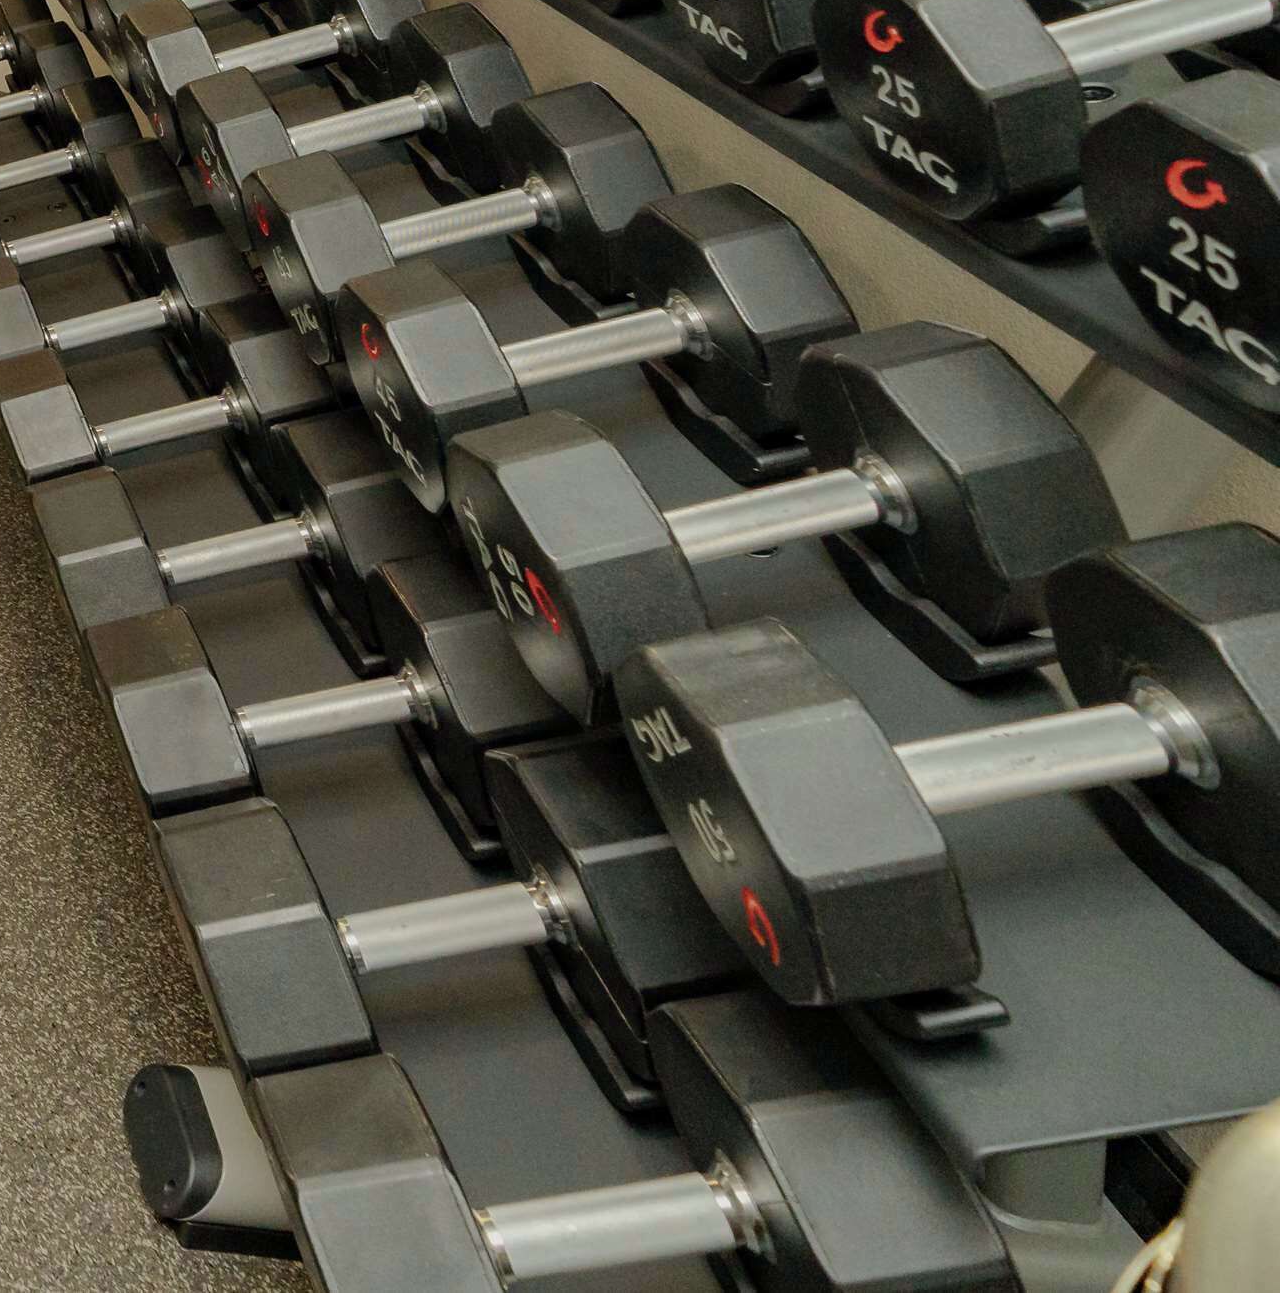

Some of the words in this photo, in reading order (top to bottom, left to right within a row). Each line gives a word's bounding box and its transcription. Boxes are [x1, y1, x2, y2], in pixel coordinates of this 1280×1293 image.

[678, 0, 748, 61] TAG
[872, 64, 921, 118] 25
[863, 115, 959, 194] TAG
[1168, 216, 1240, 291] 25
[290, 304, 319, 335] TAG
[1140, 265, 1280, 386] TAG
[631, 706, 692, 763] TAG
[688, 797, 737, 863] 50
